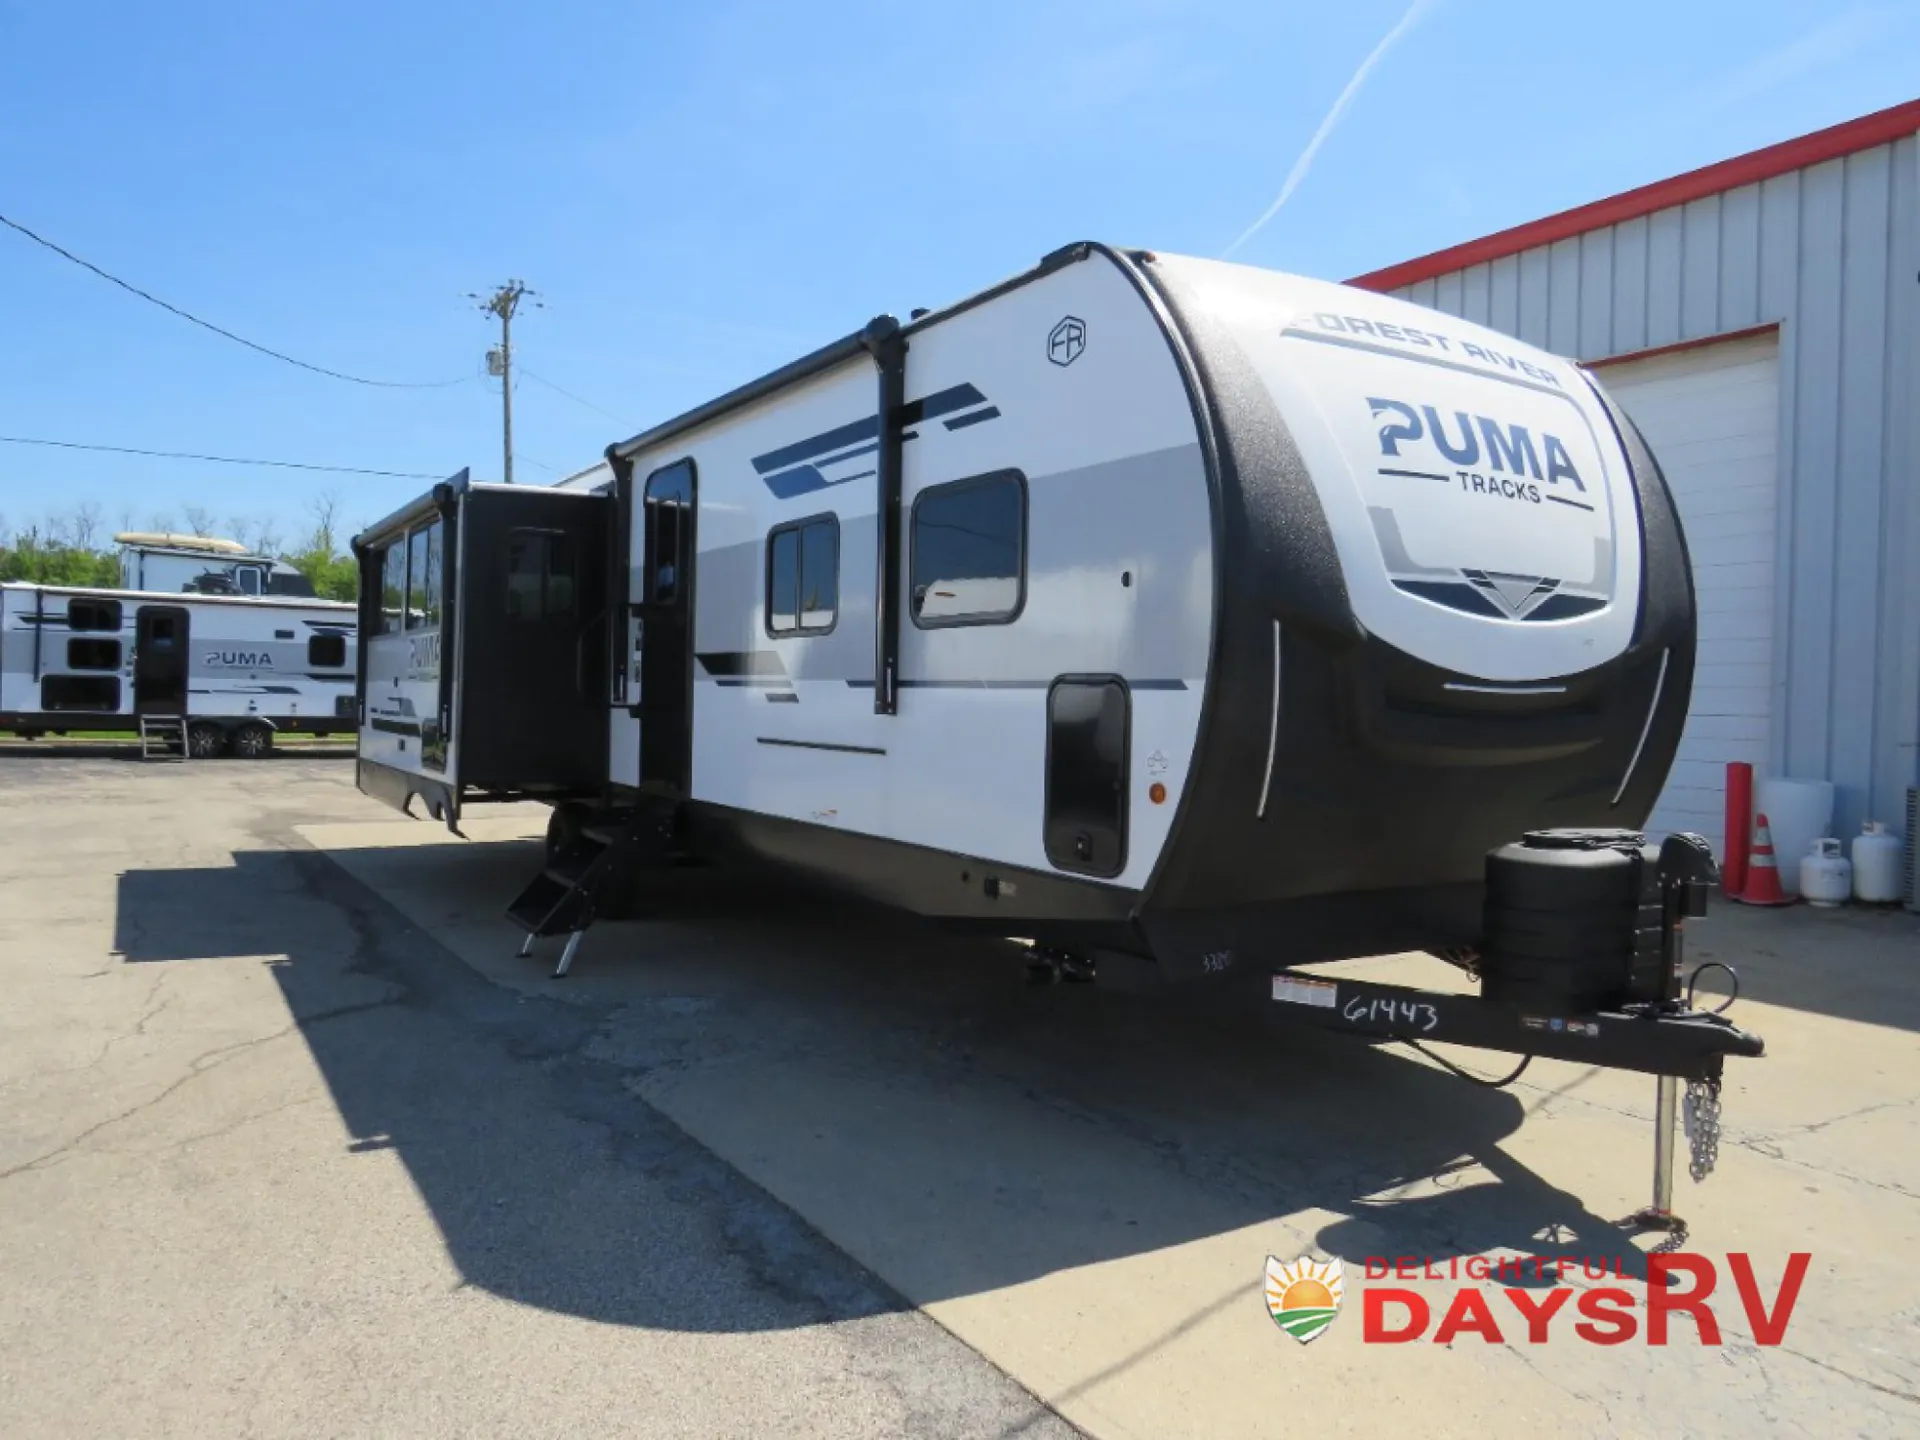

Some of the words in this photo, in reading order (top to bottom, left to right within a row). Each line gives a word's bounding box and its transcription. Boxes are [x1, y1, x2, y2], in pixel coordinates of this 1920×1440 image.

[1288, 311, 1451, 351] OREST
[1459, 341, 1563, 388] RIVER
[1365, 397, 1587, 493] PUMA
[1456, 470, 1542, 504] TRACKS
[205, 651, 275, 666] PUMA
[1343, 995, 1438, 1032] 61443
